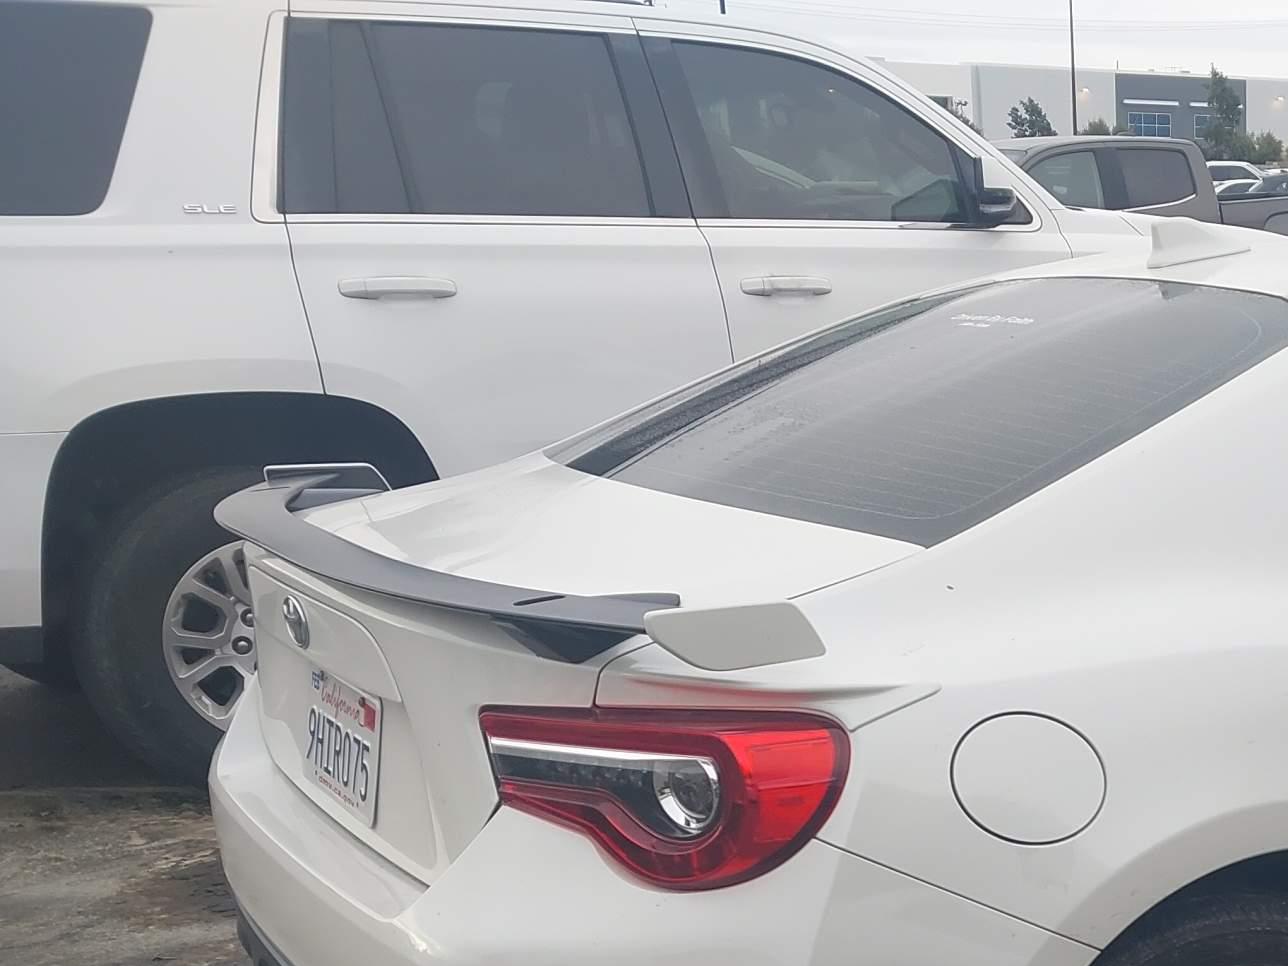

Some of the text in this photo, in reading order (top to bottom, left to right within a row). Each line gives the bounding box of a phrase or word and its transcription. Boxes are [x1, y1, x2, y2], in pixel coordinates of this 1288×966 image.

[183, 203, 237, 215] SLE
[320, 682, 360, 720] California
[306, 707, 370, 802] 9HIR075
